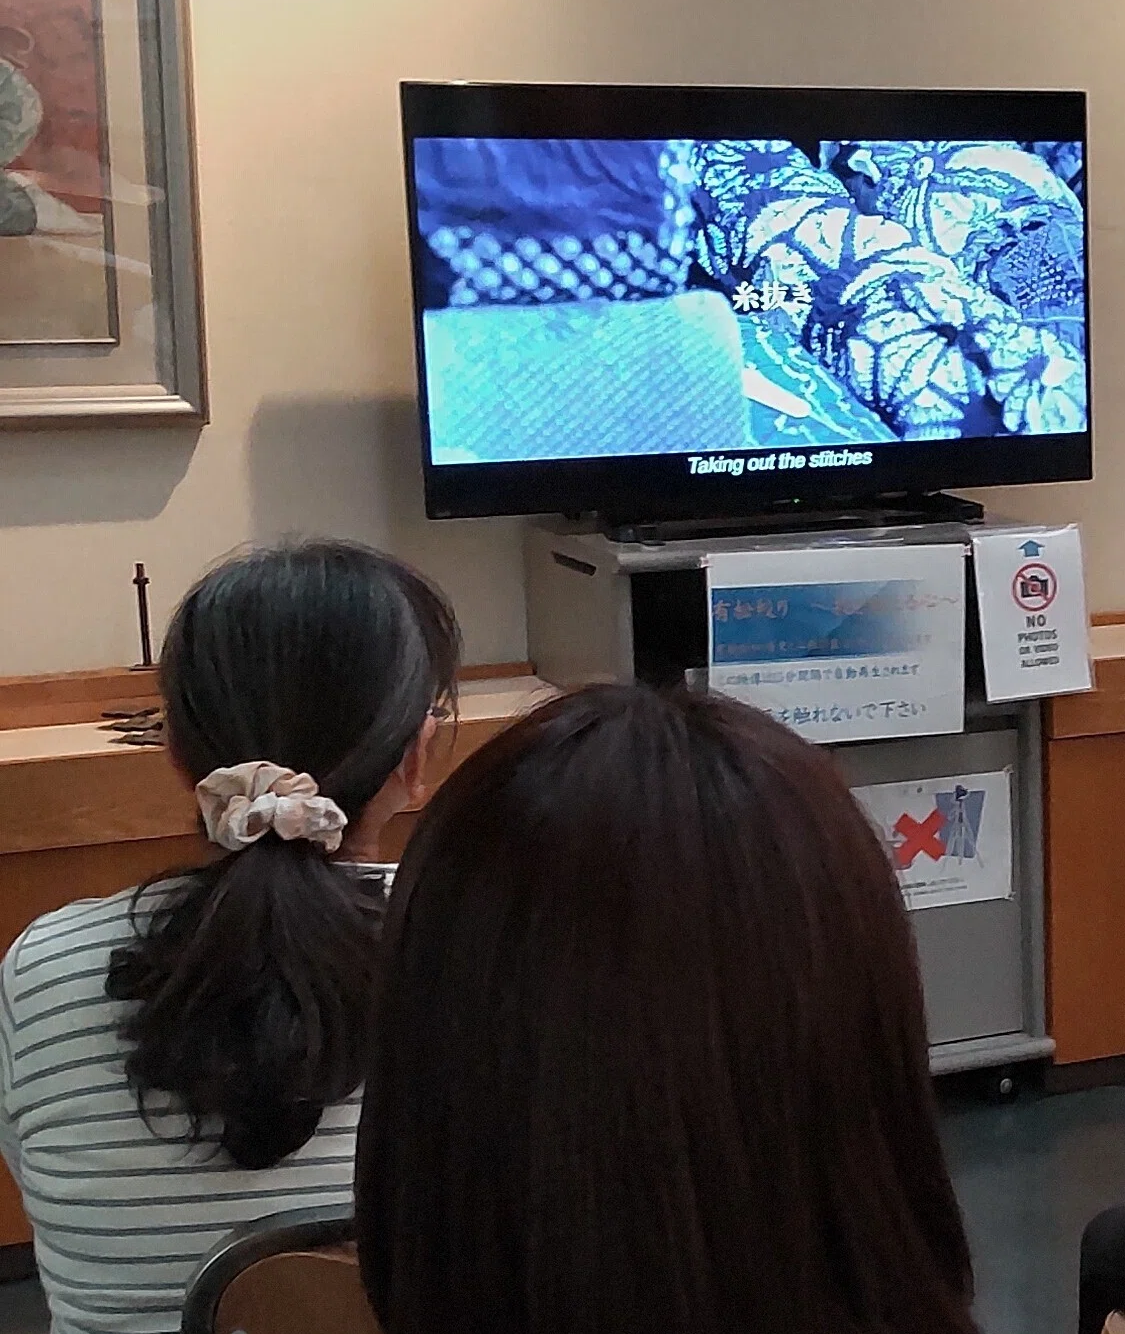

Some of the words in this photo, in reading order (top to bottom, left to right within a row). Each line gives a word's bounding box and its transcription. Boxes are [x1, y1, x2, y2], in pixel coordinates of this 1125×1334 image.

[732, 280, 814, 313] 糸抜き
[687, 453, 745, 476] Taking
[746, 453, 776, 472] out
[777, 451, 806, 470] the
[808, 448, 873, 468] stitches
[1025, 614, 1047, 628] NO
[1017, 629, 1058, 643] PHOTOS
[762, 699, 927, 726] を触れないで下さい
